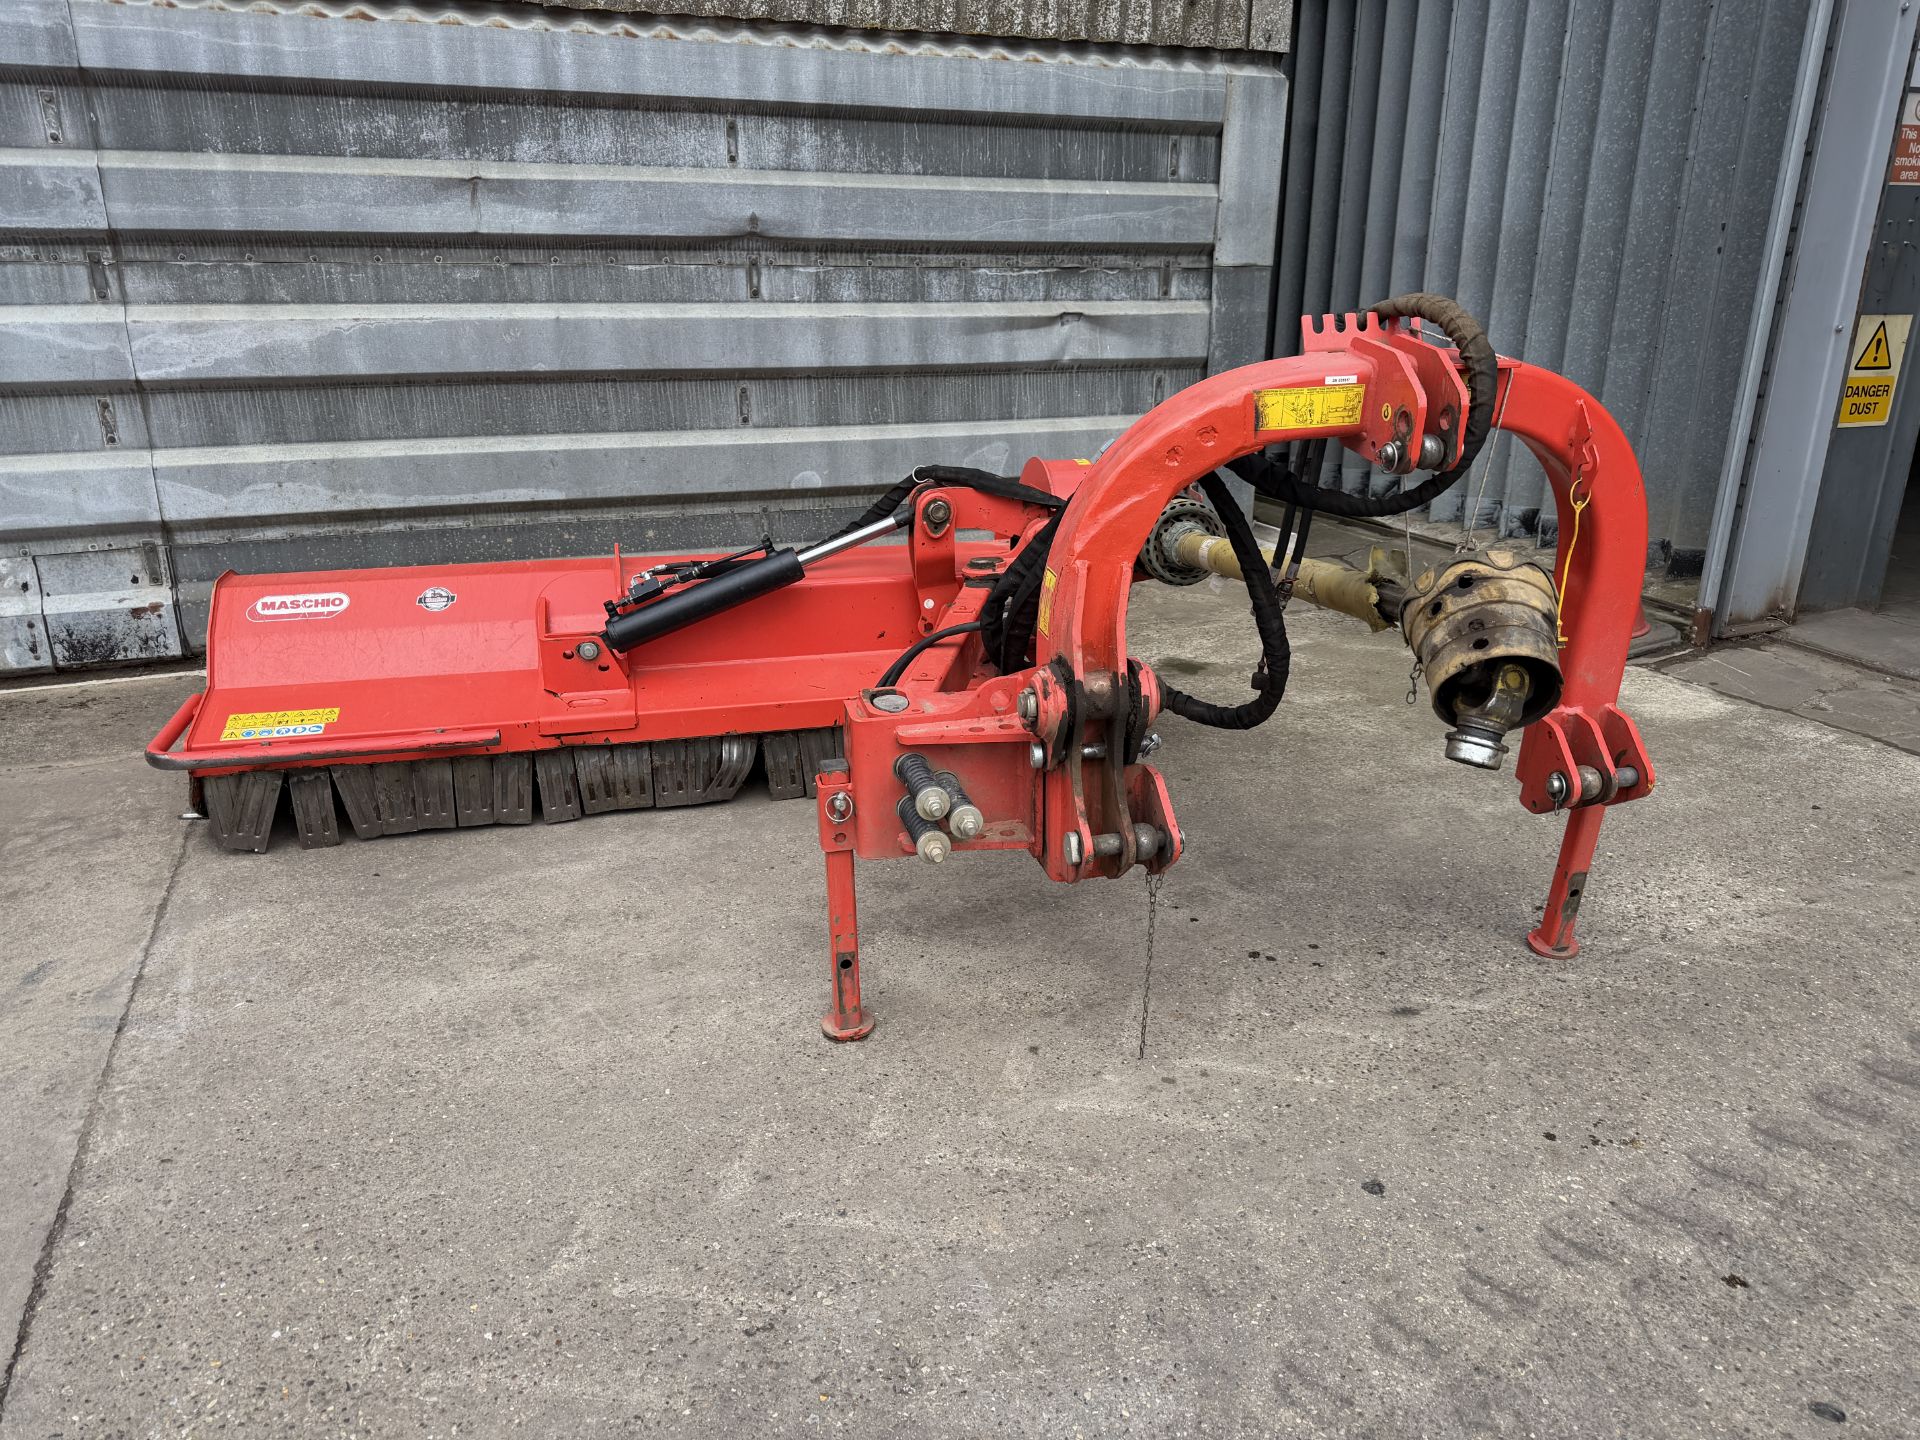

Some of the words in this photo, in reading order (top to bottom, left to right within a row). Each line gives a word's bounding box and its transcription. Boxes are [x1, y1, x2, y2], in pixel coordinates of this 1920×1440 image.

[1902, 127, 1917, 139] This
[1909, 142, 1920, 153] No
[1900, 170, 1918, 180] area
[1845, 385, 1890, 398] DANGER
[1849, 402, 1879, 415] DUST
[261, 597, 344, 611] MASCHIO
